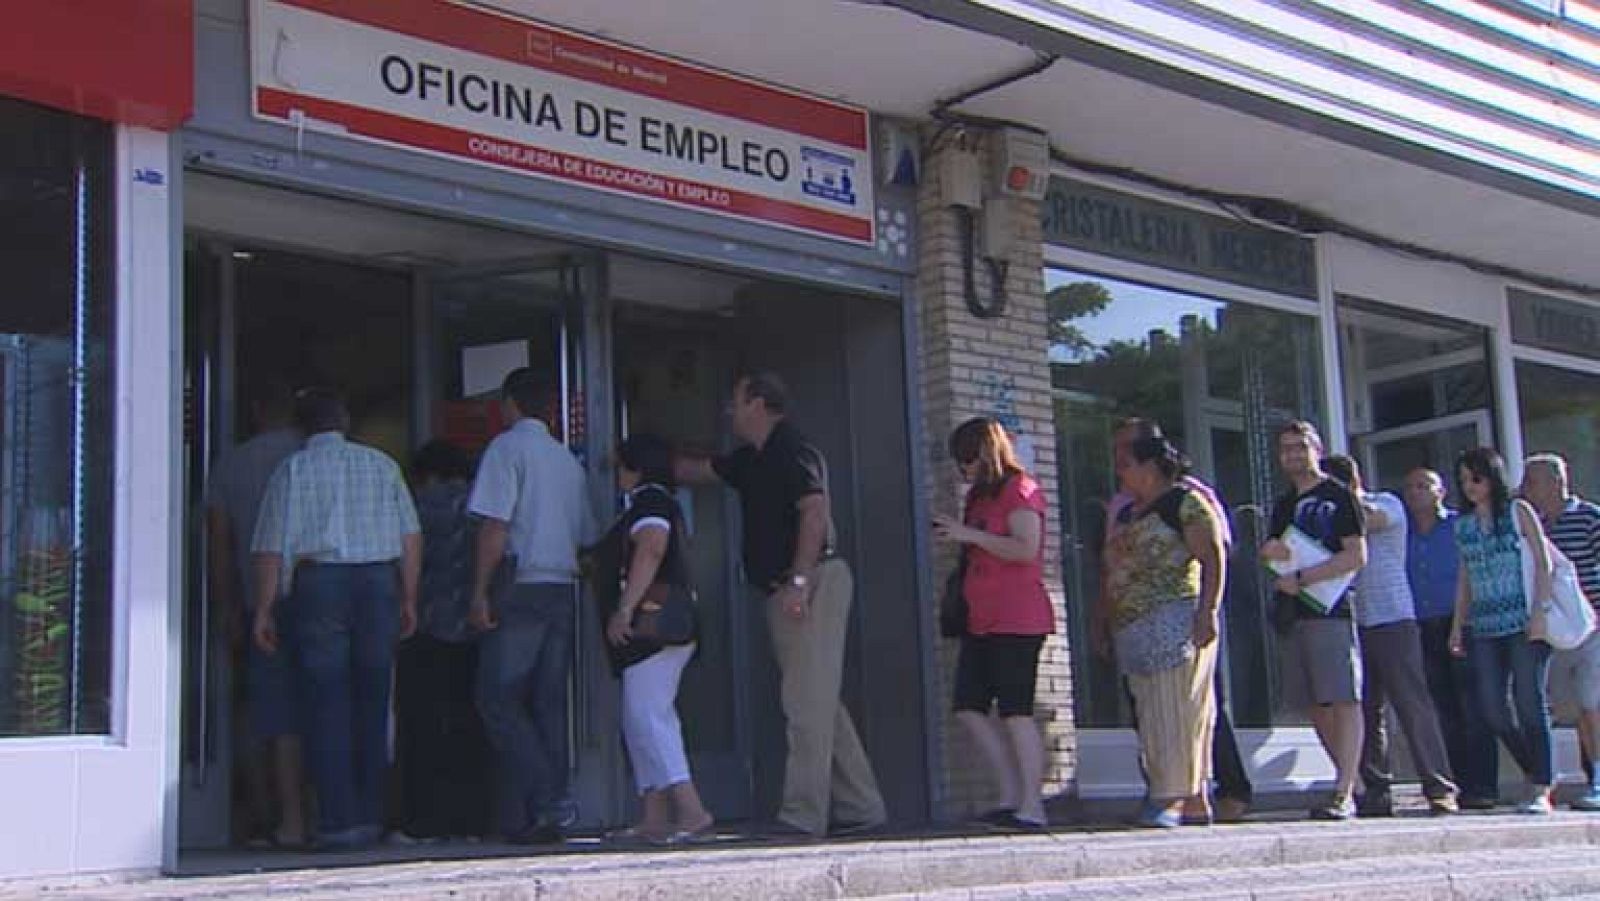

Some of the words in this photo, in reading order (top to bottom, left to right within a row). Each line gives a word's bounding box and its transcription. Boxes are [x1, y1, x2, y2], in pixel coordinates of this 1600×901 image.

[380, 54, 563, 132] OFICINA
[575, 101, 629, 147] DE
[641, 117, 790, 183] EMPLEO
[562, 157, 584, 176] DE
[667, 180, 677, 195] Y
[678, 183, 731, 206] EMPLEO
